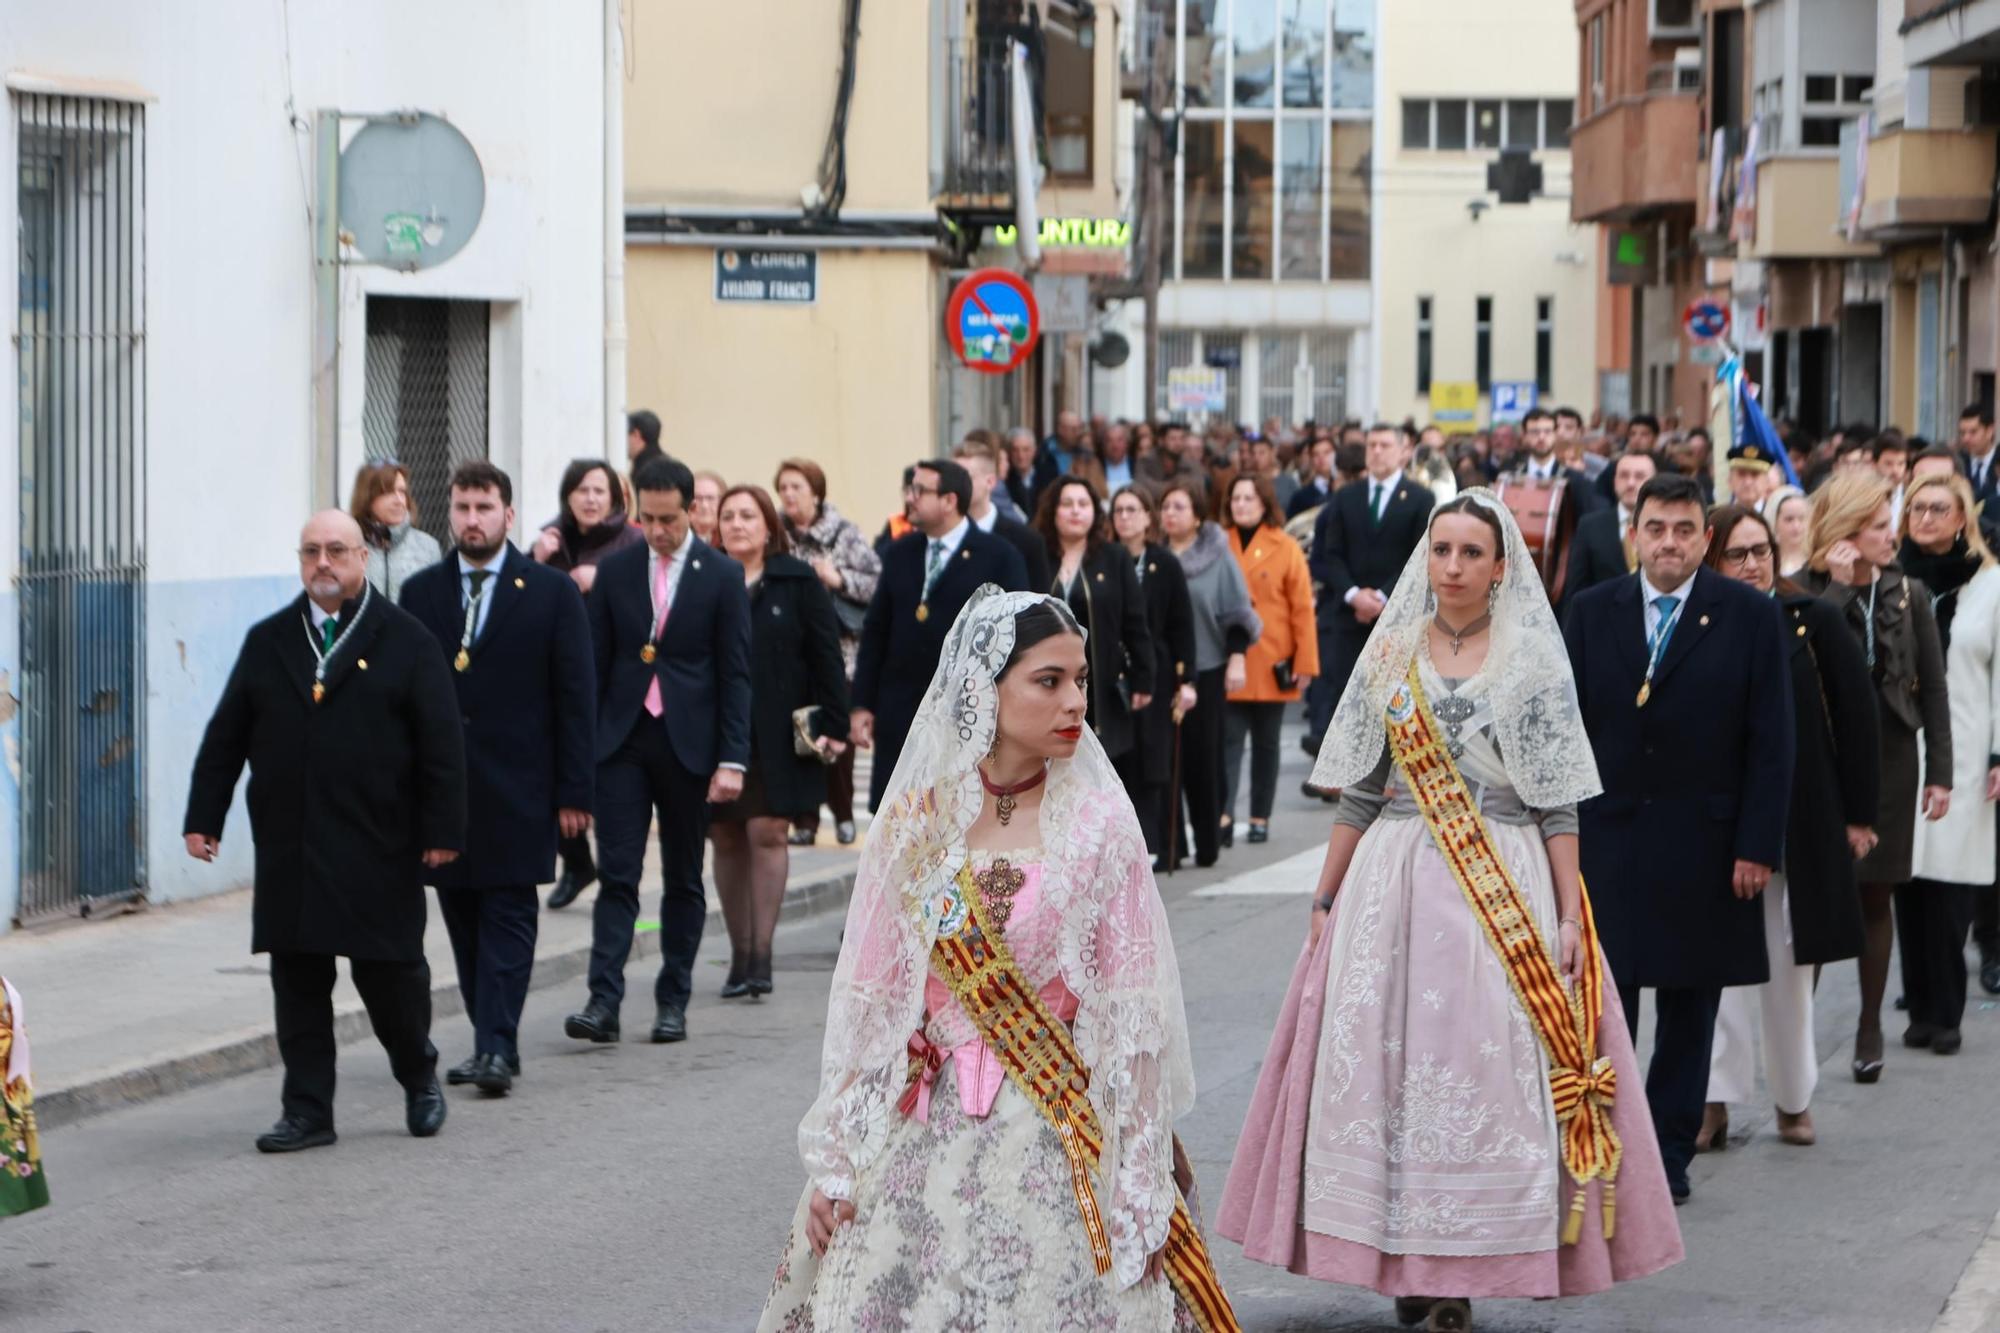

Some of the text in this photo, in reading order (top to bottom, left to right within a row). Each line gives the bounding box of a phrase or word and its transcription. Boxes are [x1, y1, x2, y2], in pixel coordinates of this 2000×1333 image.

[751, 252, 807, 268] CARRER
[722, 279, 810, 299] AVIADOR FRANCO
